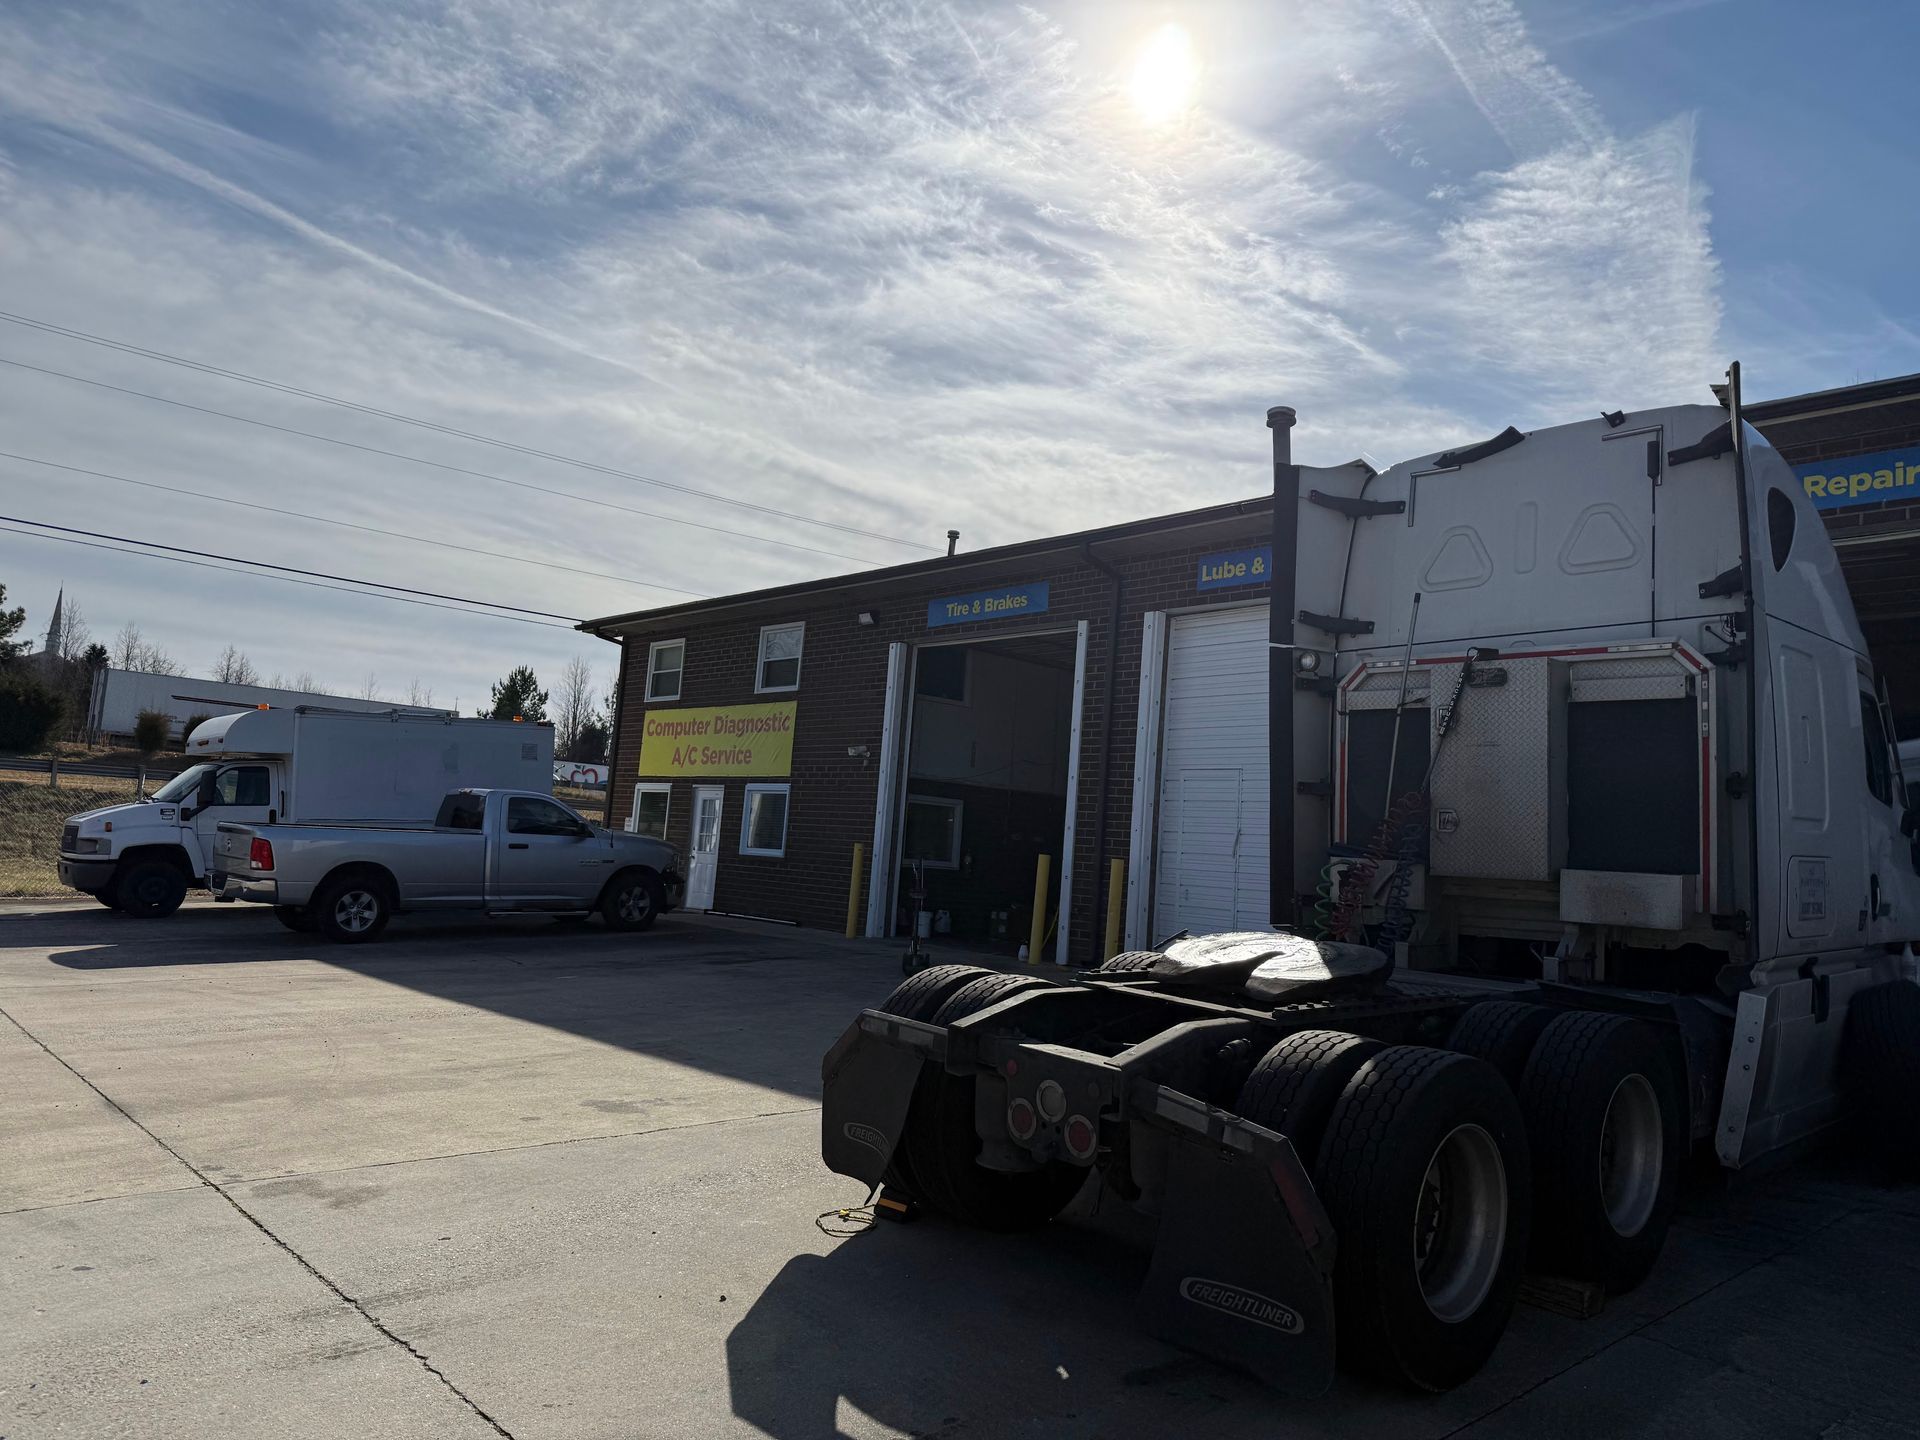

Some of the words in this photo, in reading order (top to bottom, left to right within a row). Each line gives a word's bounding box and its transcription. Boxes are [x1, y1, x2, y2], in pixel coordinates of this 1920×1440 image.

[1202, 561, 1247, 581] Lube
[1251, 557, 1265, 575] &
[946, 602, 969, 617] Tire
[972, 599, 980, 614] &
[984, 594, 1027, 613] Brakes
[647, 717, 711, 740] Computer
[714, 711, 791, 738] Diagnostic
[672, 744, 697, 768] A/C
[701, 745, 752, 766] Service
[1191, 1283, 1293, 1328] FREIGHTLINER
